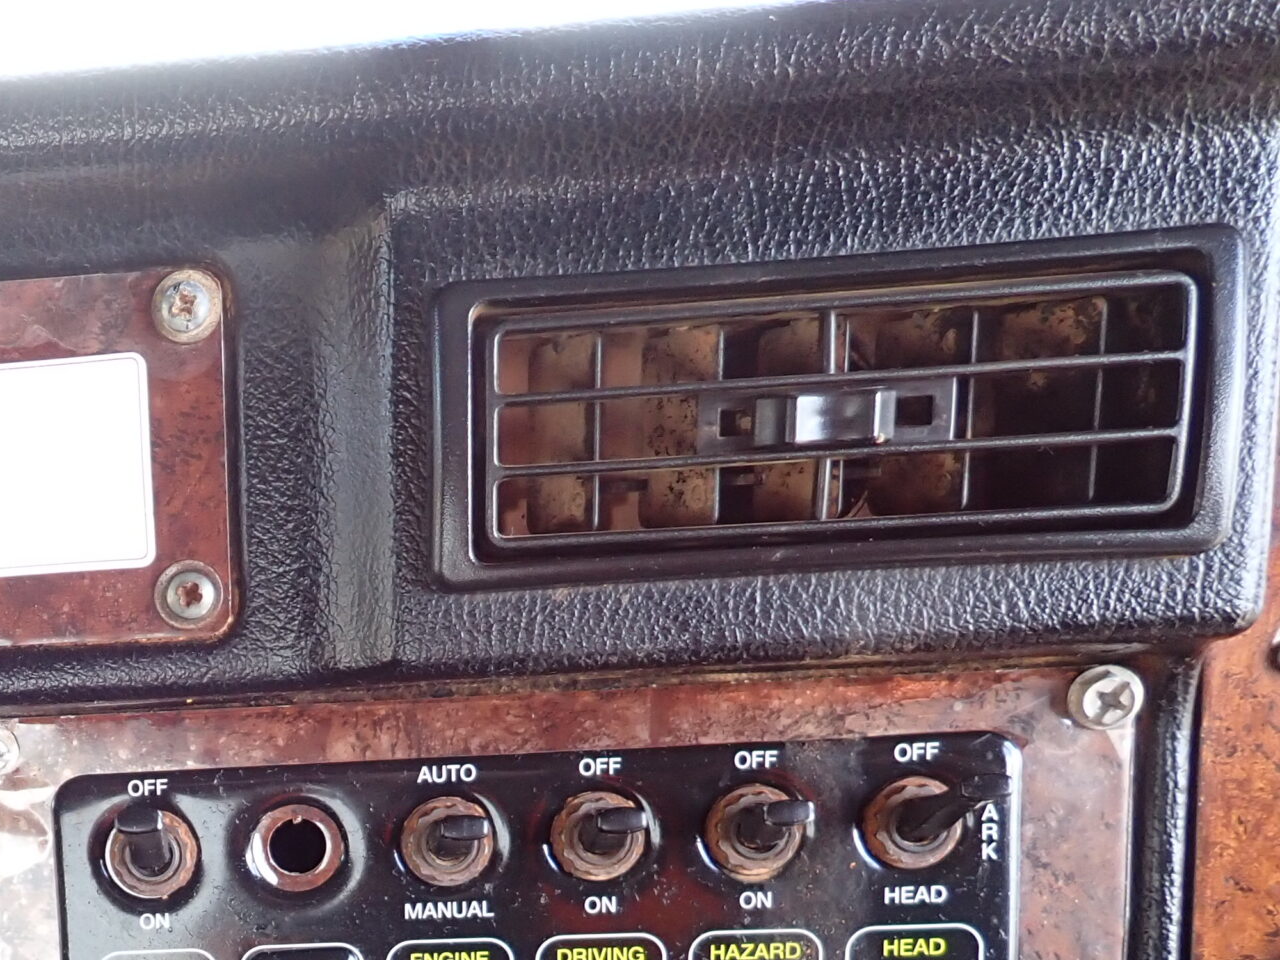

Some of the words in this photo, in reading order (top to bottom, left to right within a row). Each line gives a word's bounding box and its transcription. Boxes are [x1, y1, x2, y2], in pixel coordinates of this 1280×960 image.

[734, 750, 778, 769] OFF
[894, 742, 940, 761] OFF
[417, 764, 477, 783] AUTO
[579, 757, 622, 776] OFF
[127, 779, 169, 797] OFF
[980, 803, 999, 861] ARK
[739, 891, 773, 909] ON
[883, 886, 948, 904] HEAD
[404, 901, 495, 920] MANUAL
[584, 896, 618, 915] ON
[139, 914, 171, 931] ON
[882, 937, 946, 957] HEAD
